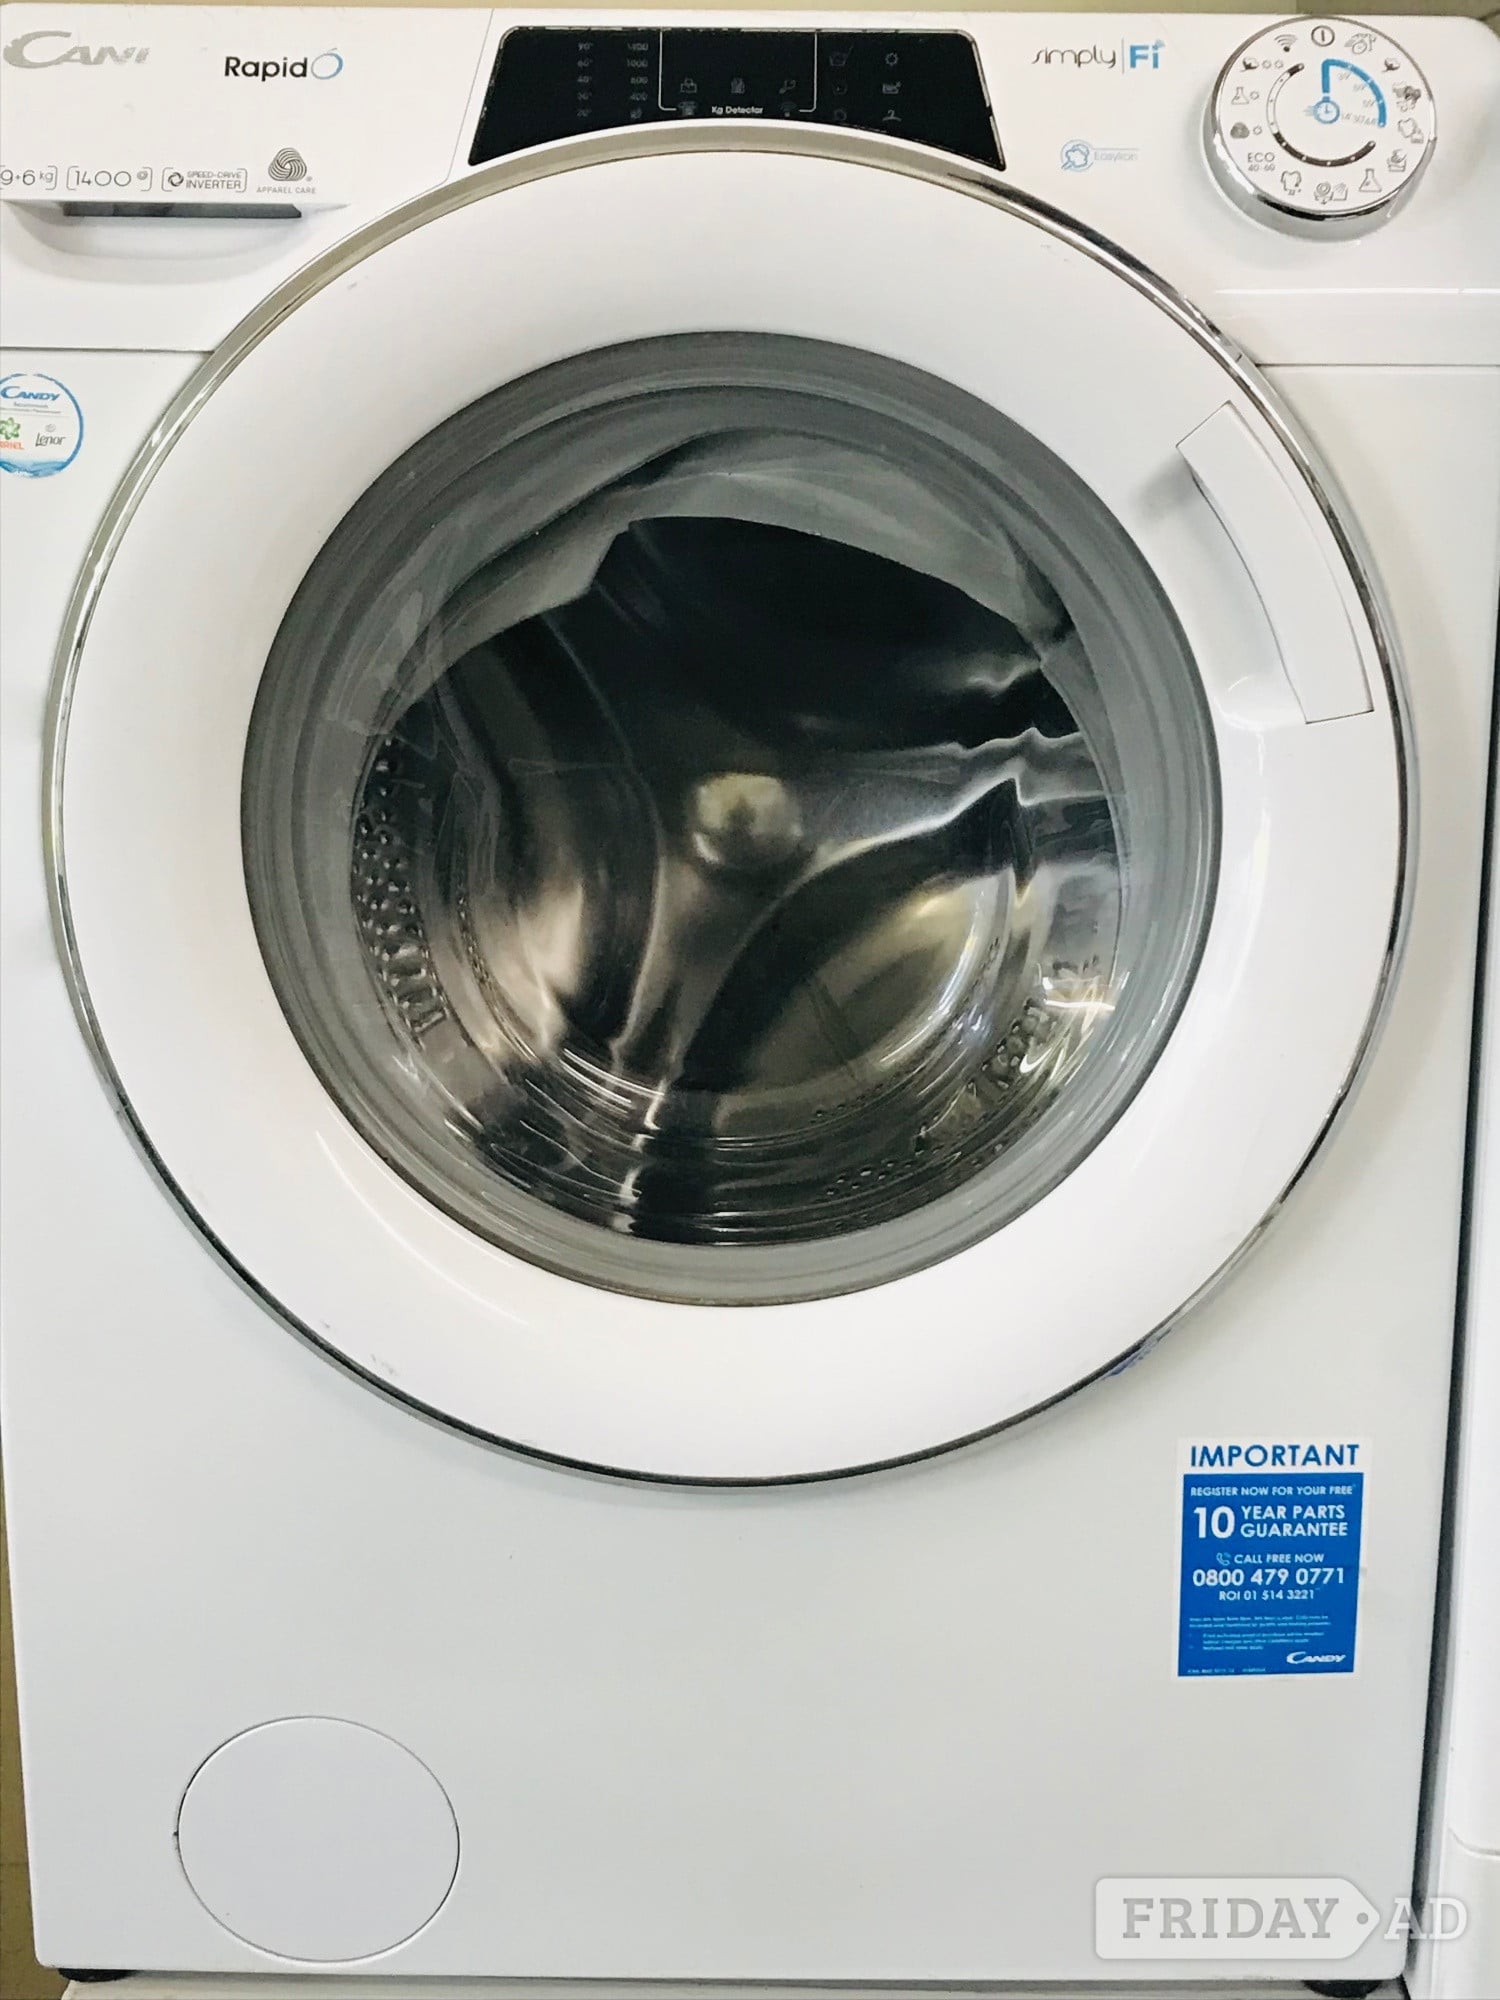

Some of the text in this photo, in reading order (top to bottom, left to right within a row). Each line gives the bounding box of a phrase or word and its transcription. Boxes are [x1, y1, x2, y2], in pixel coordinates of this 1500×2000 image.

[1032, 41, 1163, 69] simply Fi
[711, 105, 764, 116] Kg Detector
[1248, 151, 1275, 163] ECO
[75, 170, 132, 187] 1400
[186, 179, 242, 190] INVERTER
[256, 186, 292, 194] APPAREL
[35, 432, 66, 447] Lenor
[1190, 1443, 1360, 1467] IMPORTANT
[1190, 1486, 1238, 1497] REGISTER
[1241, 1486, 1270, 1496] NOW
[1272, 1486, 1294, 1496] FOR
[1296, 1486, 1327, 1496] YOUR
[1241, 1504, 1346, 1520] YEAR PARTS
[1193, 1505, 1235, 1539] 10
[1240, 1521, 1349, 1538] GUARANTEE
[1234, 1552, 1325, 1564] CALL FREE NOW
[1192, 1567, 1345, 1587] 0800 479 0771
[1219, 1590, 1241, 1601] ROI
[1243, 1590, 1257, 1601] 01
[1262, 1590, 1284, 1600] 514
[1286, 1650, 1346, 1665] CANDY
